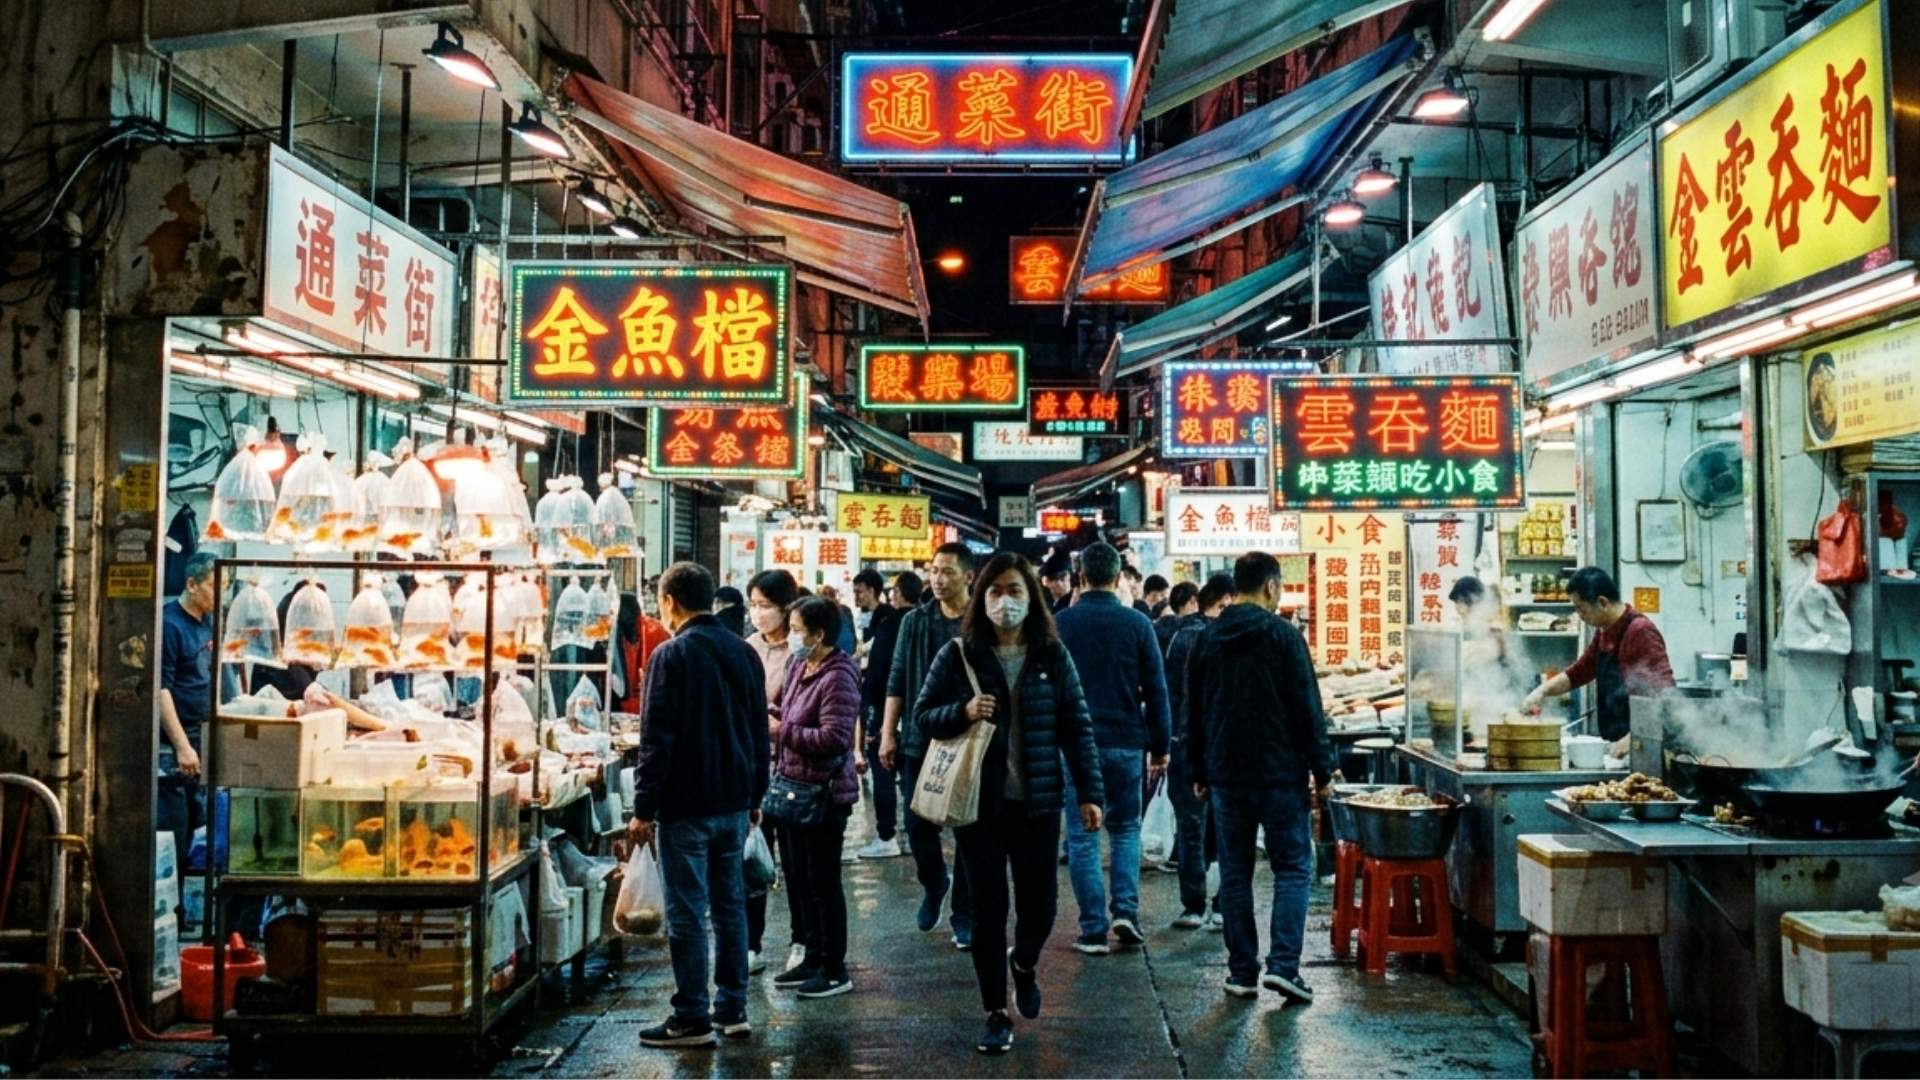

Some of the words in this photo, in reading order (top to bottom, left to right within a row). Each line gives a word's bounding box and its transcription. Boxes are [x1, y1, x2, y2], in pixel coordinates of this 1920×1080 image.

[866, 67, 1112, 146] 通菜街
[1669, 57, 1882, 296] 金雲吞麵
[295, 197, 435, 354] 通菜街
[527, 285, 774, 380] 金魚檔
[1296, 391, 1502, 454] 雲吞麵
[1317, 514, 1388, 546] 小食
